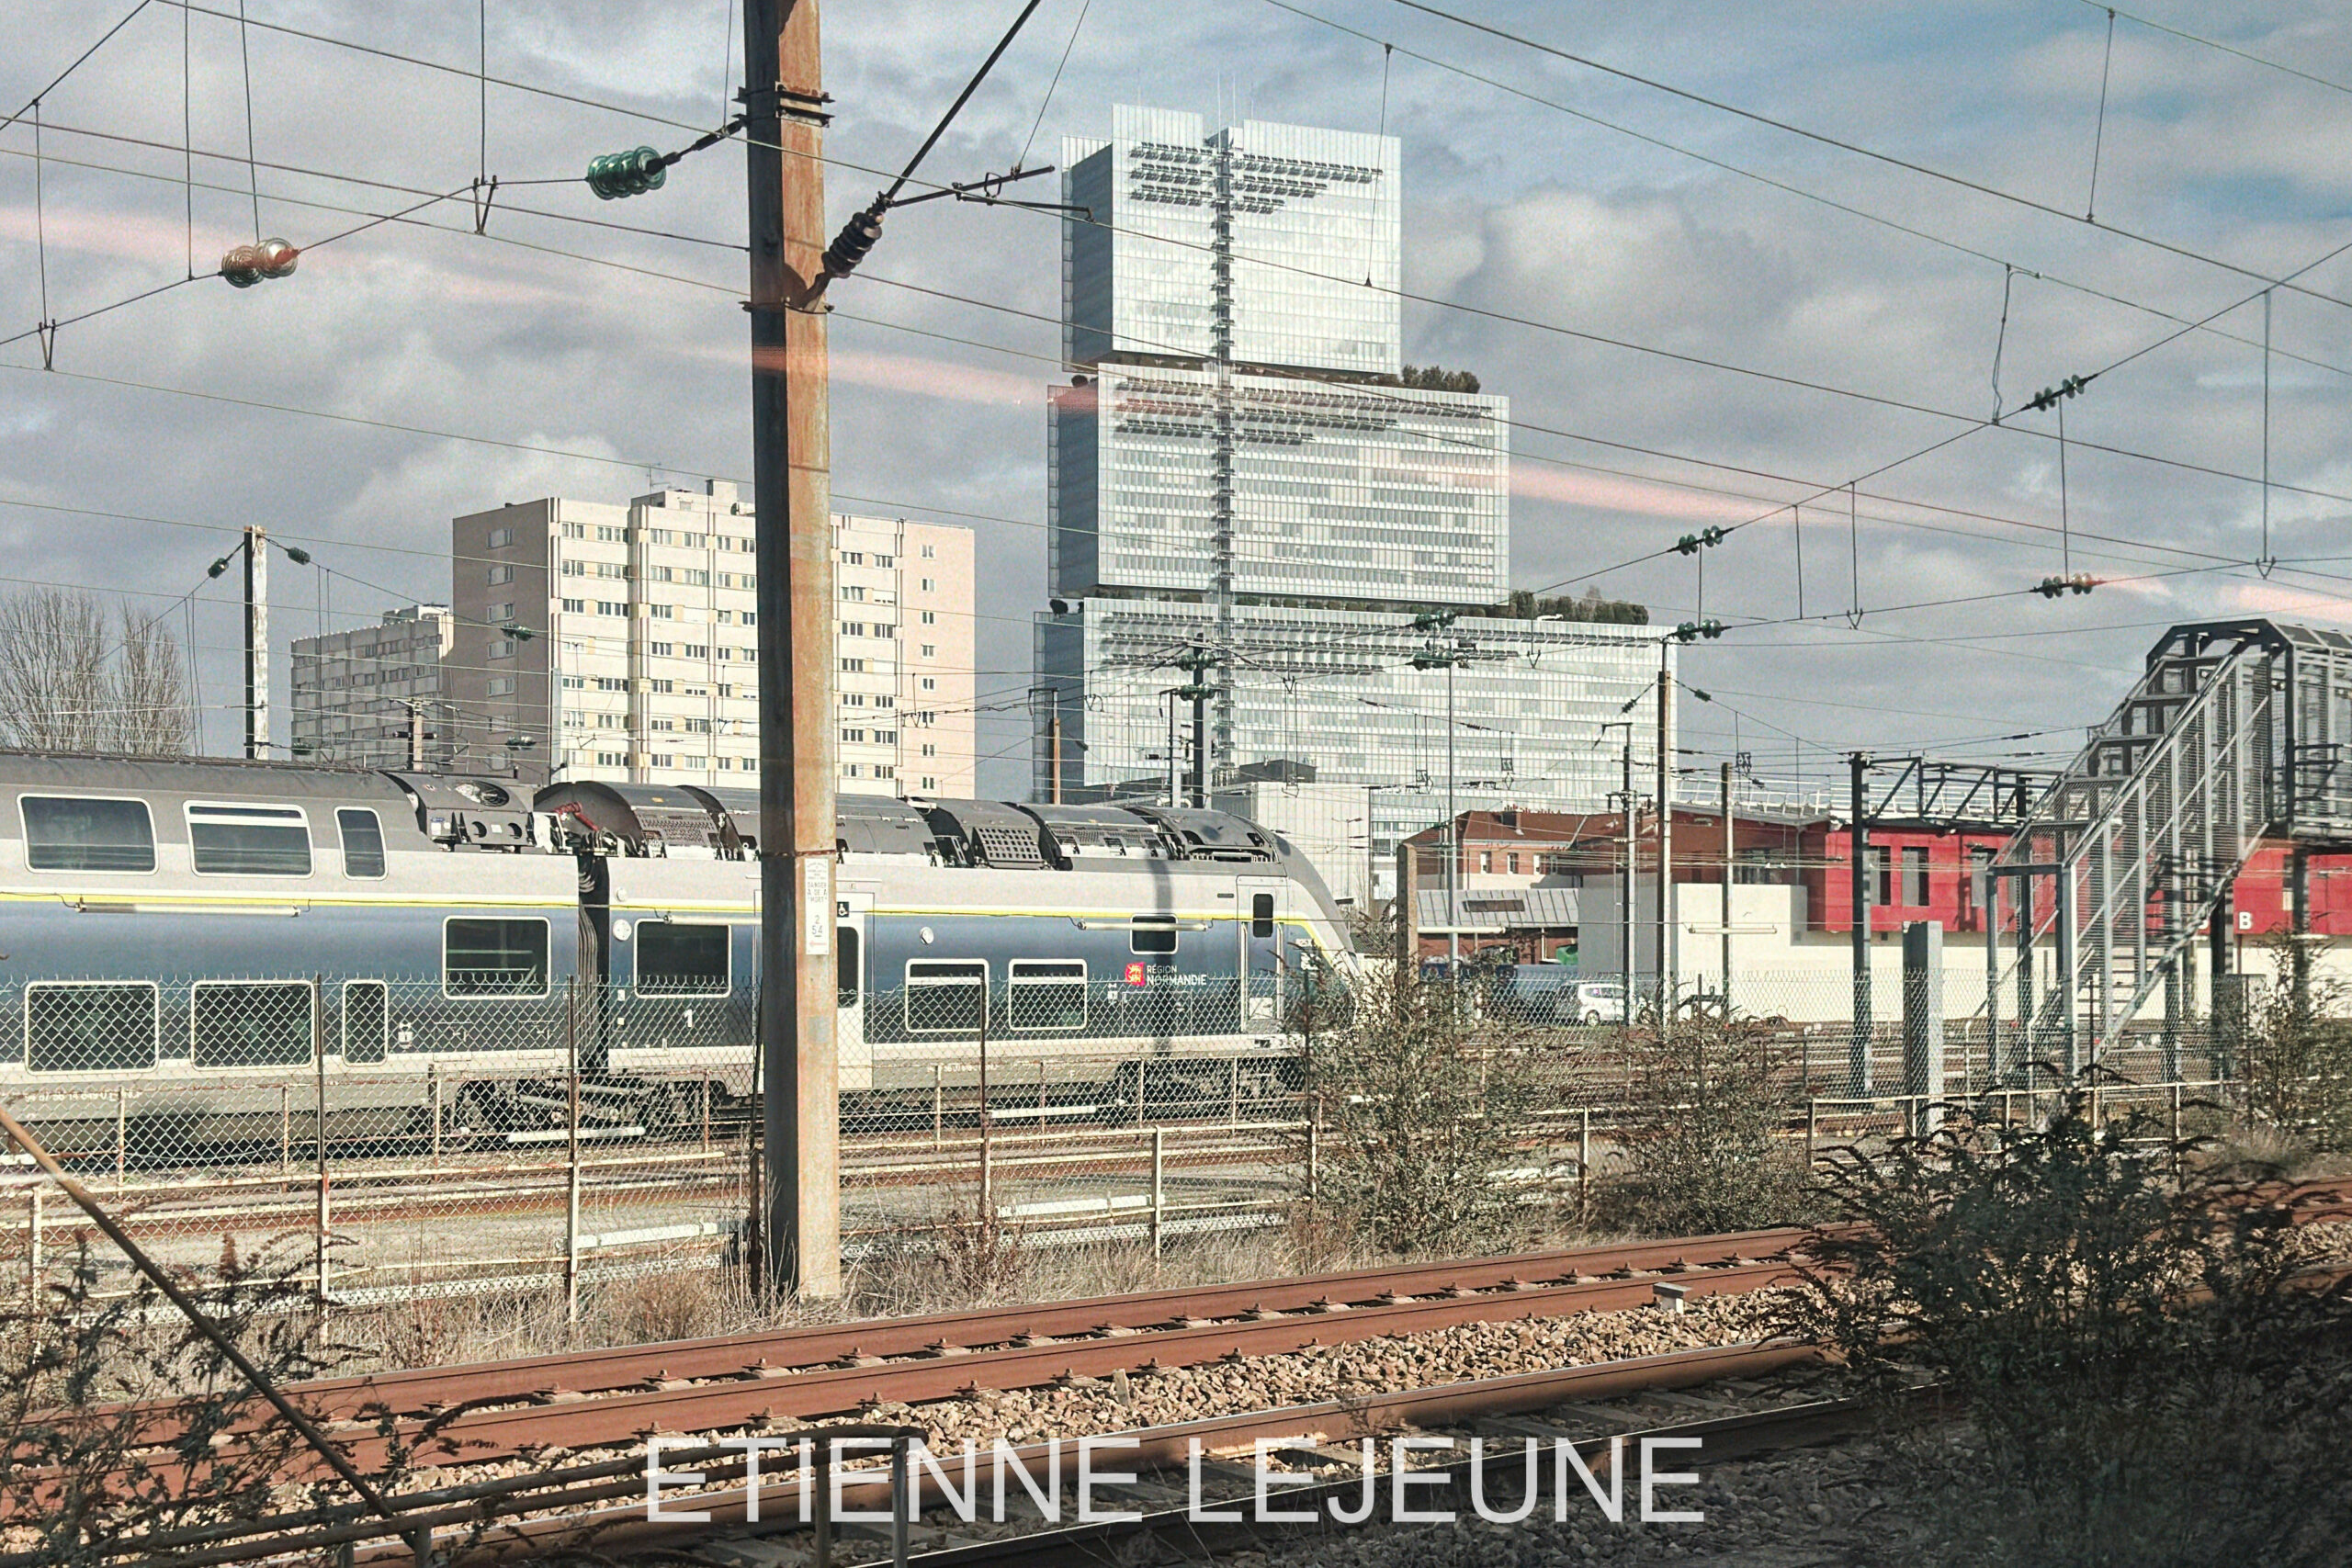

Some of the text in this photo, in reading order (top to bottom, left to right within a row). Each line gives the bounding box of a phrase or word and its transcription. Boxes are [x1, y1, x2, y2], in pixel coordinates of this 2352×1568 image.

[811, 925, 822, 935] 54
[1147, 964, 1177, 974] RÉGION
[1147, 974, 1207, 986] NORMANDIE
